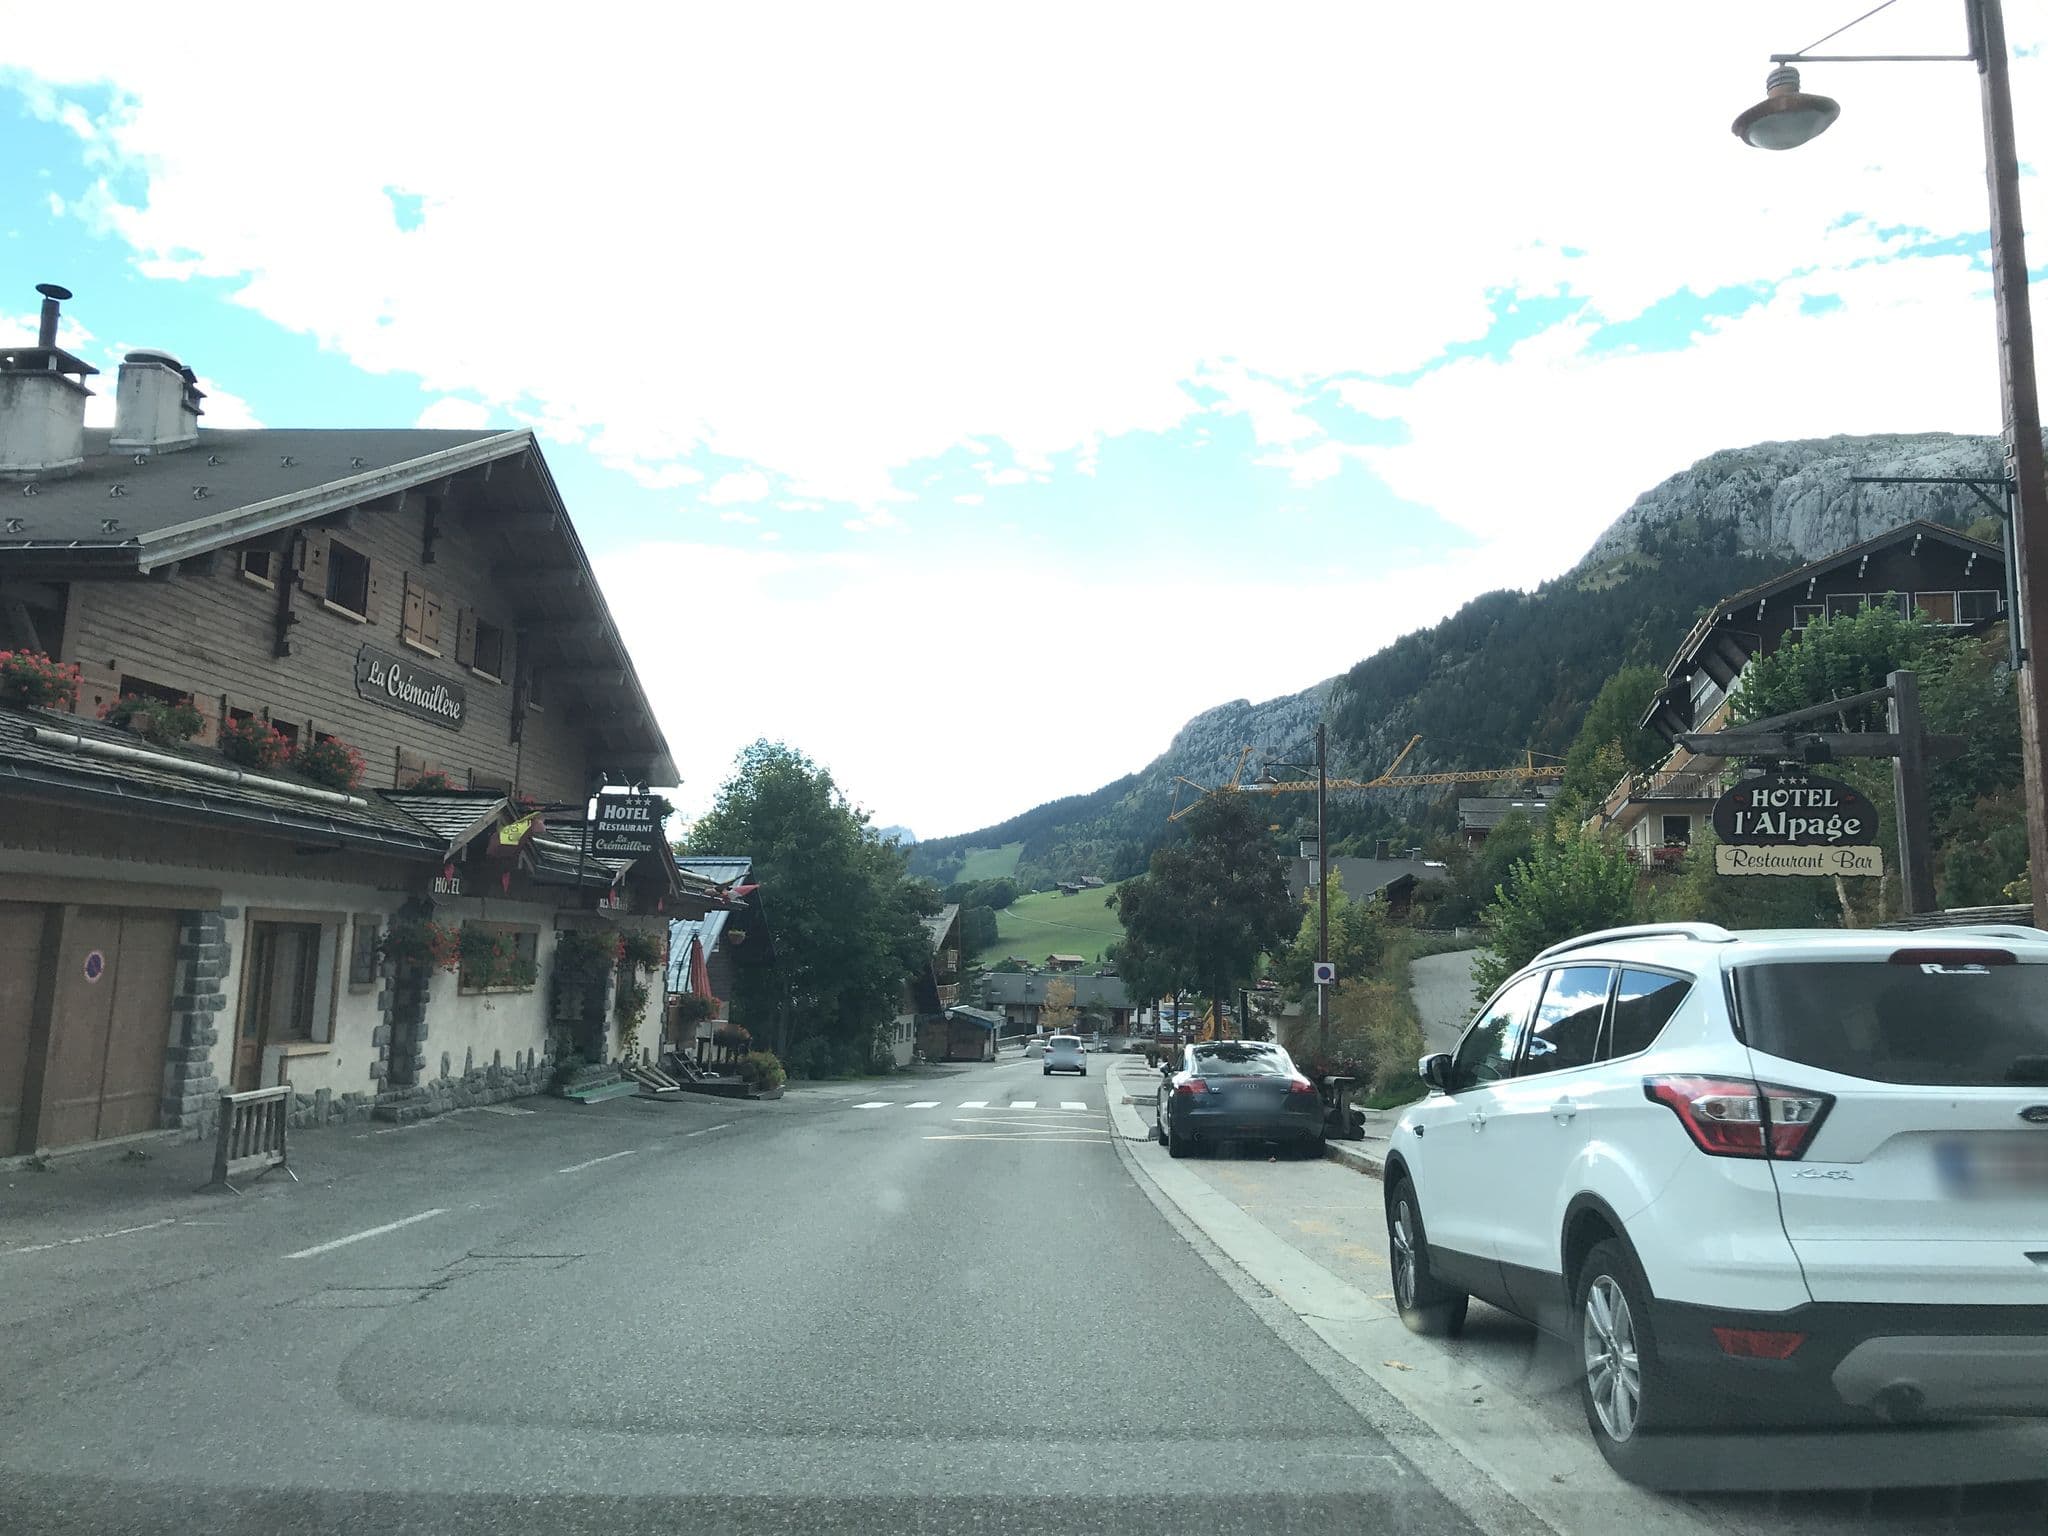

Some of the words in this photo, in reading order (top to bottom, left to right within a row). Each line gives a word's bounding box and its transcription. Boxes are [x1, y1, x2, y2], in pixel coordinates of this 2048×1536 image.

[368, 661, 385, 687] La
[387, 664, 461, 719] Crémaillère
[1751, 789, 1839, 808] HOTEL
[604, 804, 650, 820] HOTEL
[598, 821, 653, 832] RESTAURANT
[1734, 811, 1861, 842] l'Alpage
[1725, 849, 1824, 869] Restaurant
[1832, 850, 1873, 869] Bar
